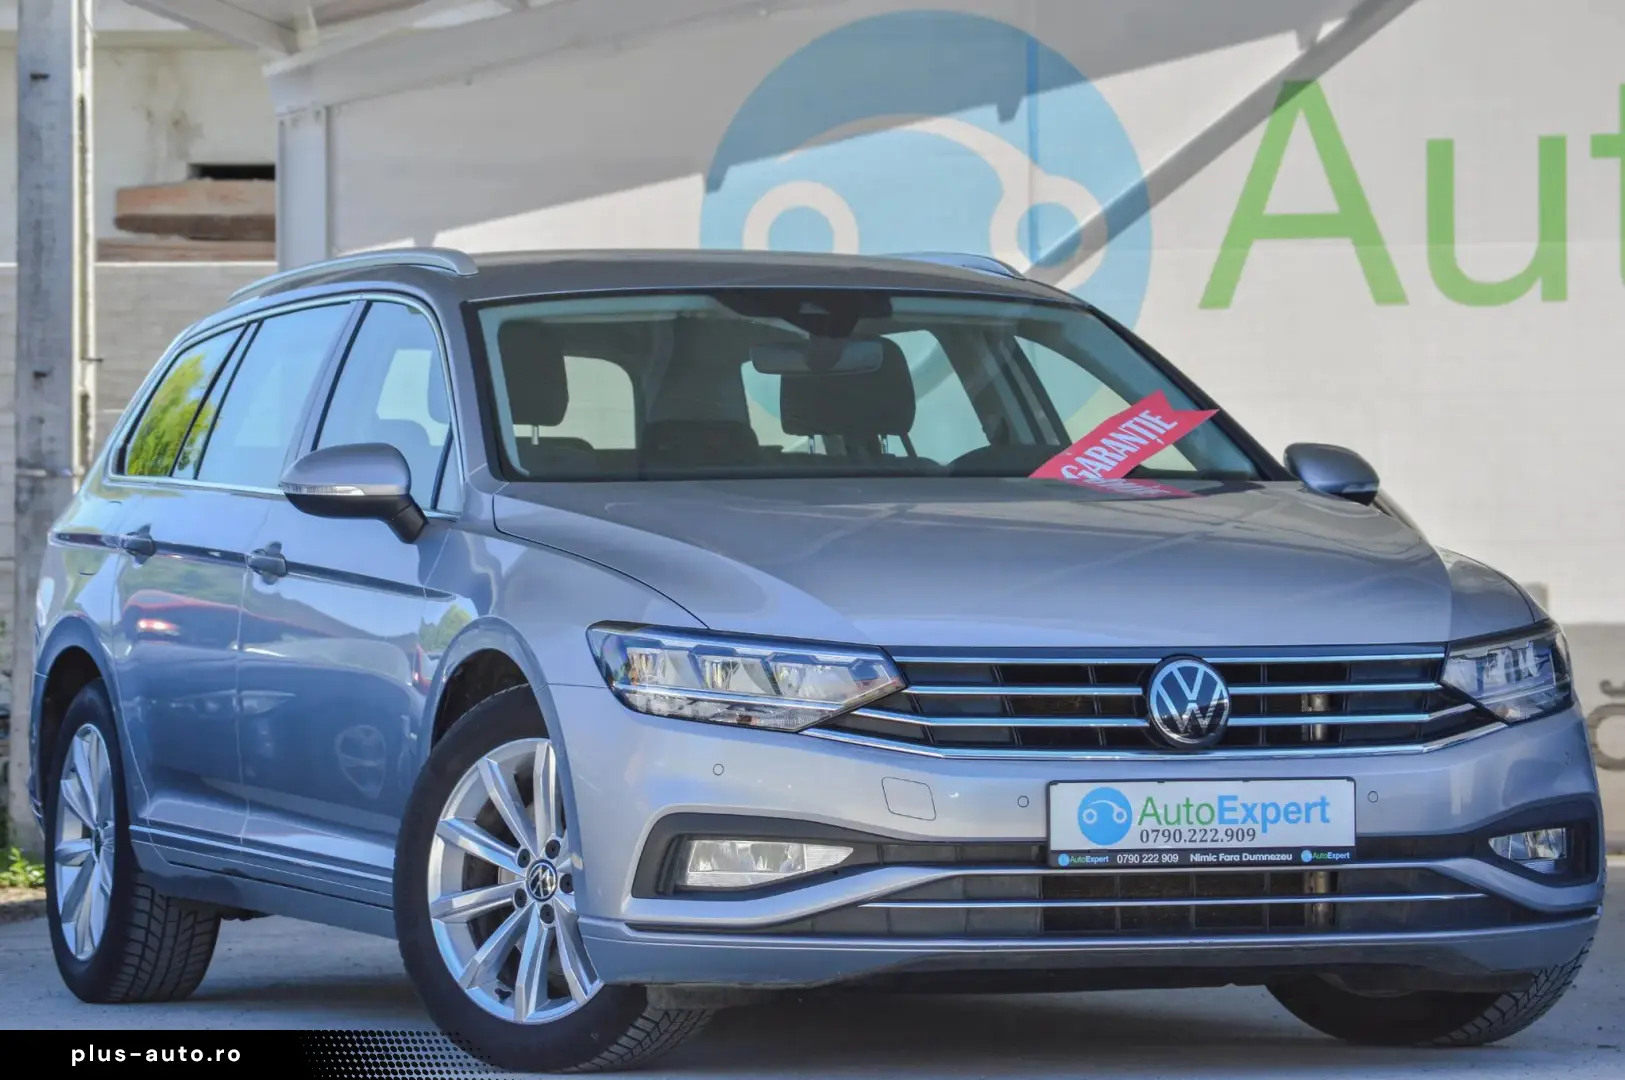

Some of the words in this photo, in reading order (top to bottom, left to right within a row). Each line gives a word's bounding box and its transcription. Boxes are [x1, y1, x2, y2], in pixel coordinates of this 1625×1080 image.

[1138, 795, 1330, 833] AutoExpert
[1140, 828, 1256, 843] 0790.222.909
[1070, 855, 1109, 864] AutoExpert
[1117, 854, 1140, 864] 0790
[1142, 854, 1159, 863] 222
[1161, 853, 1179, 863] 909
[1189, 853, 1217, 862] Nimic
[1218, 853, 1240, 862] Fara
[1242, 852, 1293, 861] Dumnezeu
[1312, 851, 1350, 860] AutoExpert
